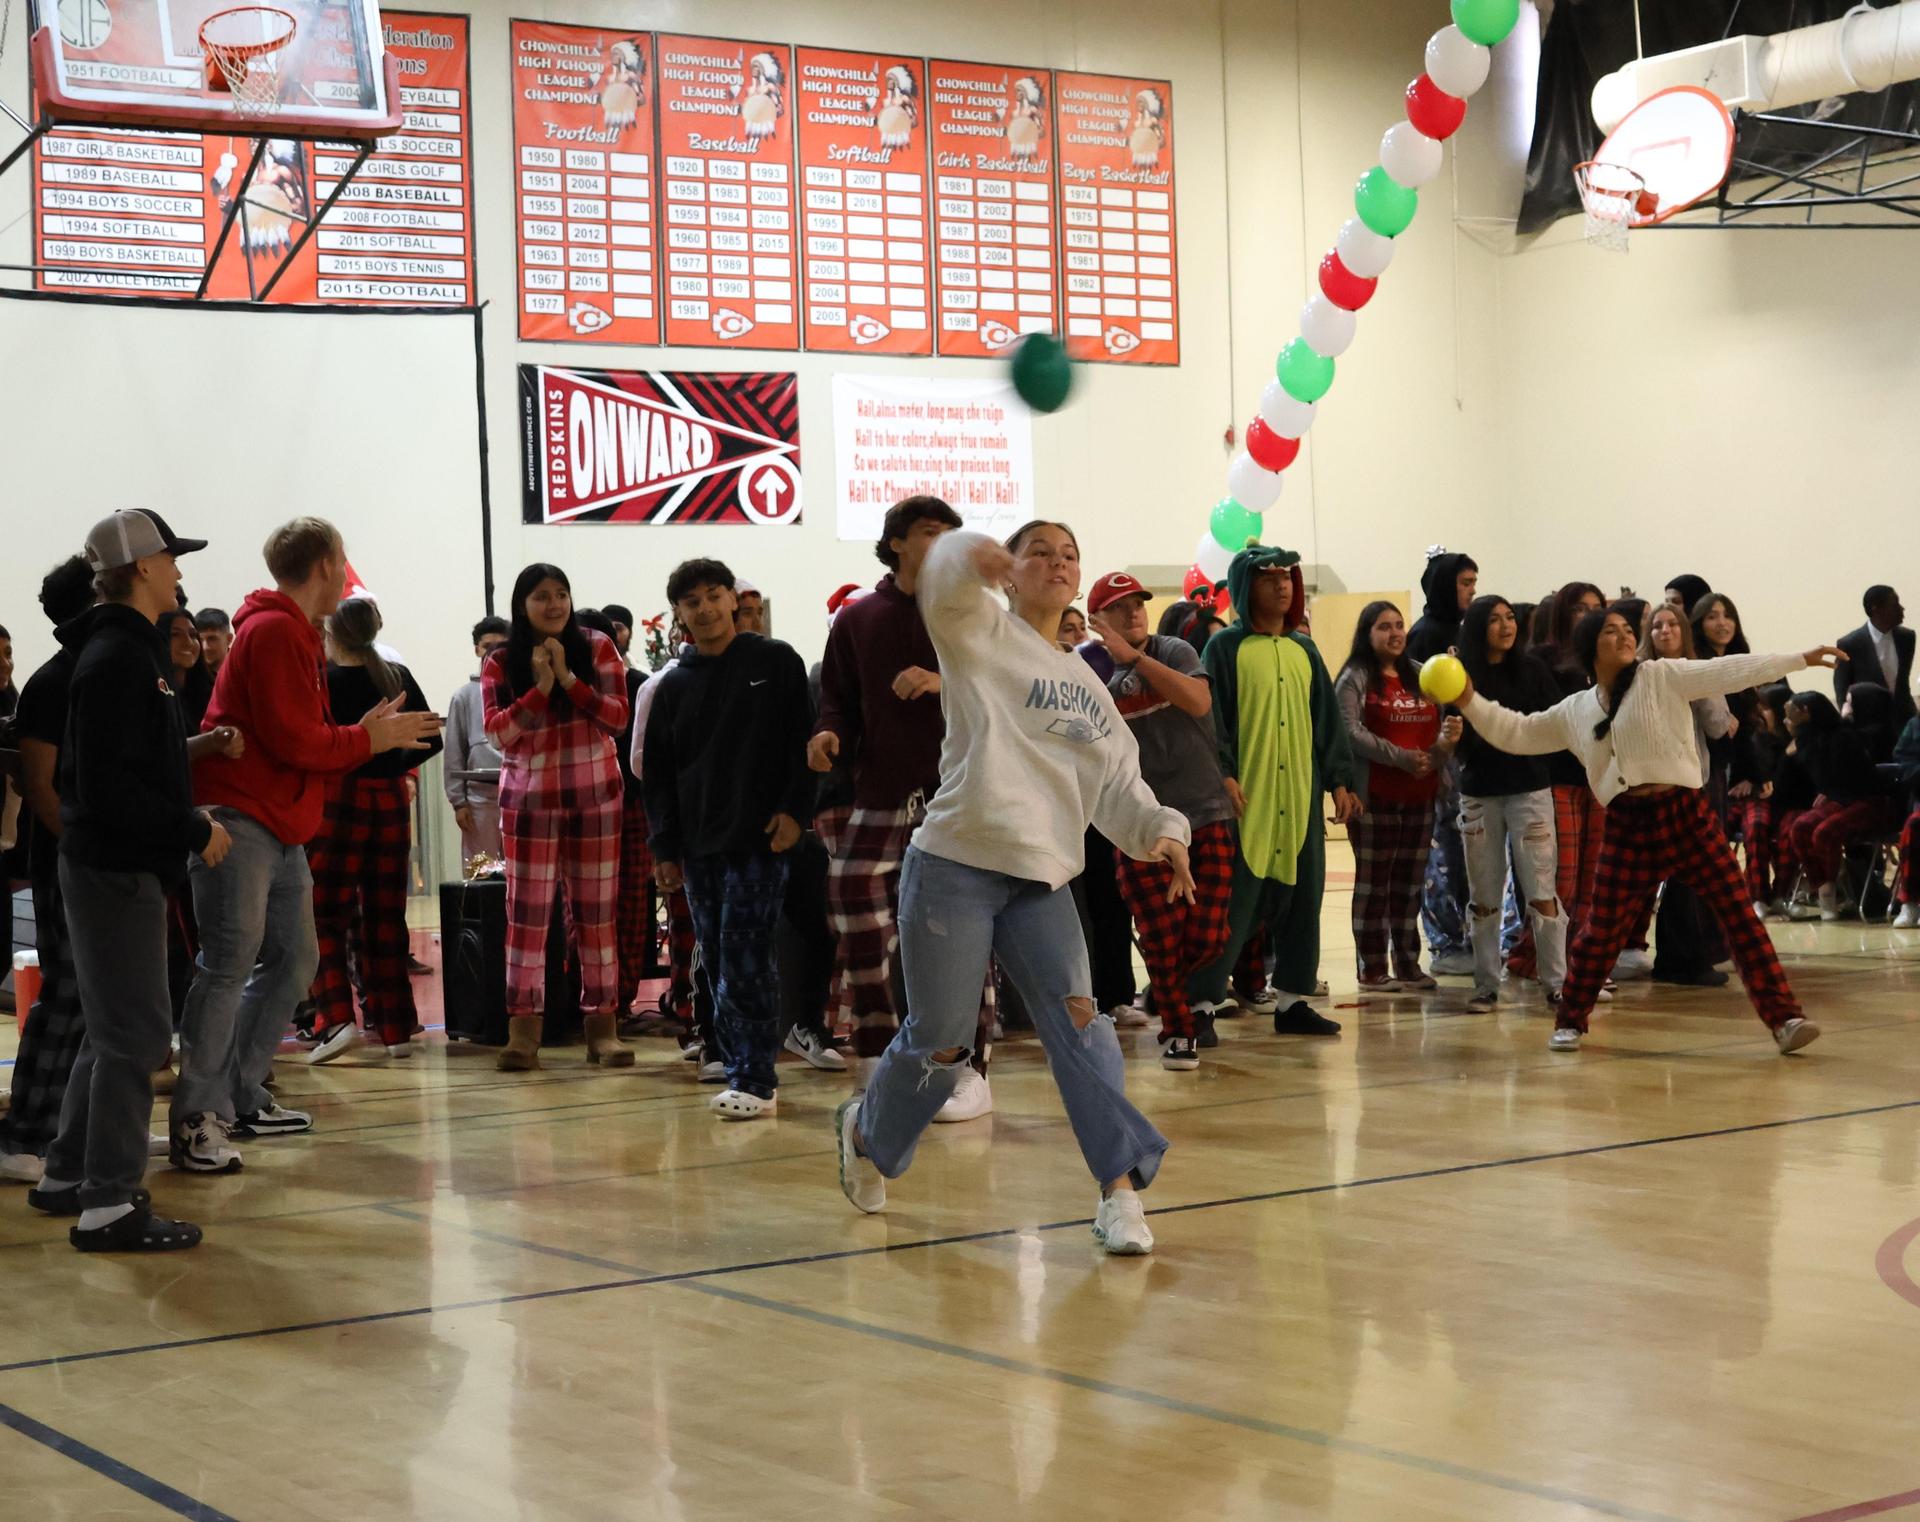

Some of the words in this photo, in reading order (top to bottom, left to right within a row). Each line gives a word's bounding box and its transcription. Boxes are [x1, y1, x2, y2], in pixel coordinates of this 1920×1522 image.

[520, 40, 601, 56] CHOWCHILLA
[518, 56, 551, 68] HIGH
[665, 53, 741, 69] CHOWCHILLA
[66, 64, 94, 77] 1951
[100, 67, 176, 83] FOOTBALL
[664, 68, 694, 80] HIGH
[803, 65, 877, 81] CHOWCHILLA
[537, 74, 585, 88] LEAGUE
[802, 81, 832, 93] HIGH
[936, 78, 1006, 93] CHOWCHILLA
[402, 91, 450, 104] EYBALL
[524, 89, 598, 104] CHAMPIONS
[681, 86, 727, 99] LEAGUE
[935, 92, 963, 104] HIGH
[1063, 89, 1128, 104] CHOWCHILLA
[670, 101, 739, 116] CHAMPIONS
[820, 97, 863, 111] LEAGUE
[1062, 104, 1088, 115] HIGH
[403, 116, 442, 128] TBALL
[808, 112, 875, 127] CHAMPIONS
[952, 109, 993, 121] LEAGUE
[542, 121, 620, 143] Football
[941, 123, 1004, 138] CHAMPIONS
[1077, 120, 1115, 132] LEAGUE
[402, 141, 454, 153] SOCCER
[688, 133, 759, 153] Baseball
[1067, 133, 1127, 148] CHAMPIONS
[47, 141, 72, 153] 1987
[77, 143, 113, 156] GIRLS
[117, 147, 197, 163] BASKETBALL
[528, 152, 554, 162] 1950
[572, 155, 597, 166] 1980
[828, 144, 892, 164] Softball
[368, 163, 406, 175] GIRLS
[411, 166, 445, 176] GOLF
[674, 161, 698, 172] 1920
[756, 168, 780, 178] 1993
[938, 151, 970, 168] Girls
[976, 153, 1048, 174] Basketball
[66, 168, 96, 180] 1989
[102, 170, 177, 186] BASEBALL
[812, 172, 835, 181] 1991
[853, 174, 876, 184] 2007
[1064, 162, 1095, 181] Boys
[1101, 165, 1169, 185] Basketball
[529, 176, 554, 186] 1951
[572, 178, 598, 189] 2004
[984, 184, 1006, 194] 2001
[340, 186, 370, 196] 008
[376, 187, 450, 201] BASEBALL
[674, 185, 699, 196] 1958
[758, 191, 782, 202] 2003
[1070, 190, 1092, 199] 1974
[53, 194, 83, 205] 1994
[89, 196, 129, 208] BOYS
[134, 199, 192, 212] SOCCER
[530, 200, 556, 211] 1955
[574, 203, 599, 214] 2008
[813, 195, 836, 204] 1994
[854, 198, 877, 208] 2018
[675, 209, 700, 220] 1959
[759, 214, 782, 224] 2010
[984, 206, 1007, 215] 2002
[1071, 211, 1092, 221] 1975
[344, 212, 369, 222] 2008
[374, 213, 440, 226] FOOTBALL
[814, 218, 837, 228] 1995
[66, 220, 97, 232] 1994
[103, 223, 177, 237] SOFTBALL
[531, 225, 556, 235] 1962
[574, 228, 600, 239] 2012
[984, 228, 1007, 239] 2003
[340, 236, 365, 246] 2011
[370, 236, 437, 249] SOFTBALL
[676, 233, 700, 243] 1960
[759, 238, 783, 248] 2015
[50, 244, 76, 257] 1999
[79, 246, 113, 259] BOYS
[117, 249, 198, 263] BASKETBALL
[531, 250, 557, 260] 1963
[576, 252, 599, 263] 2015
[985, 250, 1007, 261] 2004
[334, 260, 361, 270] 2015
[365, 261, 398, 272] BOYS
[402, 263, 444, 274] TENNIS
[677, 257, 700, 267] 1977
[718, 260, 741, 270] 1989
[815, 265, 839, 275] 2003
[59, 272, 89, 283] 2002
[96, 274, 190, 288] VOLLEYBALL
[532, 274, 557, 285] 1967
[576, 276, 601, 286] 2016
[677, 281, 702, 291] 1980
[719, 283, 742, 293] 1990
[323, 284, 363, 294] 2015
[369, 285, 462, 298] FOOTBALL
[815, 288, 839, 297] 2004
[533, 298, 558, 309] 1977
[948, 294, 971, 304] 1997
[678, 305, 701, 314] 1981
[816, 311, 840, 321] 2005
[927, 401, 944, 424] long
[948, 407, 963, 424] may
[967, 402, 979, 420] she
[983, 403, 1004, 426] reign
[550, 390, 567, 498] REDSKINS
[569, 390, 713, 499] ONWARD
[856, 429, 871, 446] Hail
[875, 430, 883, 447] to
[886, 429, 899, 446] her
[961, 433, 977, 448] true
[980, 432, 1008, 449] remain
[855, 453, 864, 471] So
[868, 459, 878, 471] we
[882, 454, 906, 471] salute
[945, 455, 958, 472] her
[961, 456, 990, 477] praises
[993, 456, 1009, 478] long
[849, 479, 868, 502] Hail
[871, 481, 881, 502] to
[942, 481, 960, 504] Hail
[969, 481, 987, 504] Hail
[996, 481, 1013, 504] Hail
[1108, 574, 1132, 587] C
